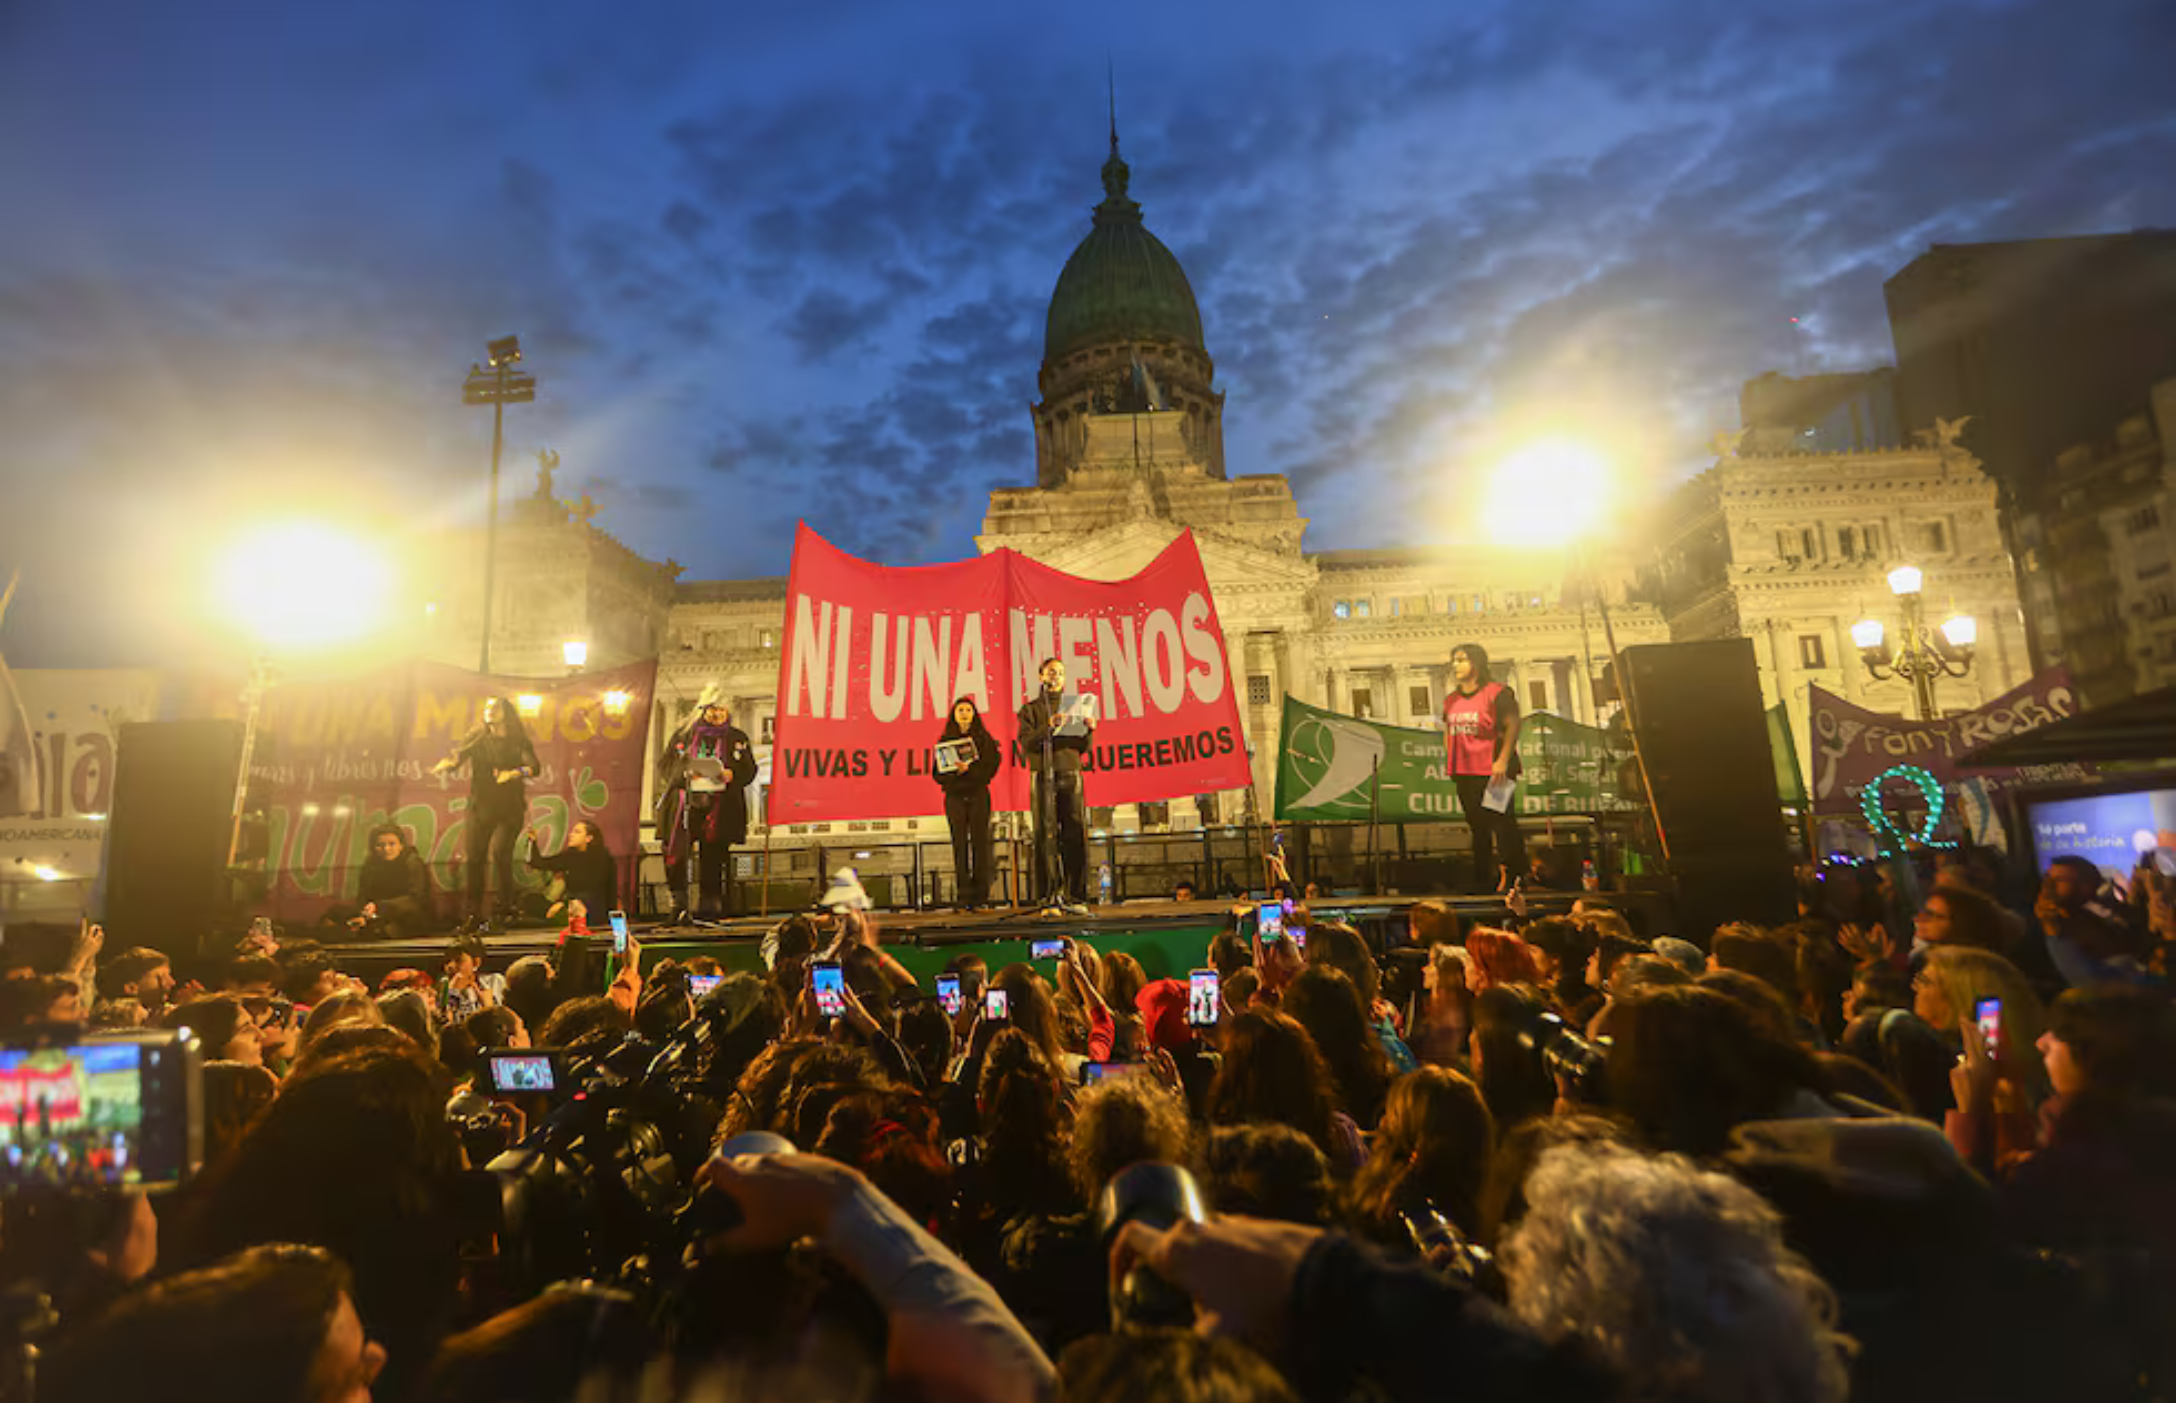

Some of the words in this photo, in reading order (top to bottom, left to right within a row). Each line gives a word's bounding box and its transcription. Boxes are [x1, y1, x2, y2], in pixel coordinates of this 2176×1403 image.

[787, 592, 852, 720] NI
[869, 611, 990, 723] UNA
[1009, 592, 1225, 720] MENOS
[412, 688, 632, 743] MNOS
[784, 749, 867, 778] VIVAS
[878, 749, 898, 776] Y
[1516, 740, 1587, 758] acional
